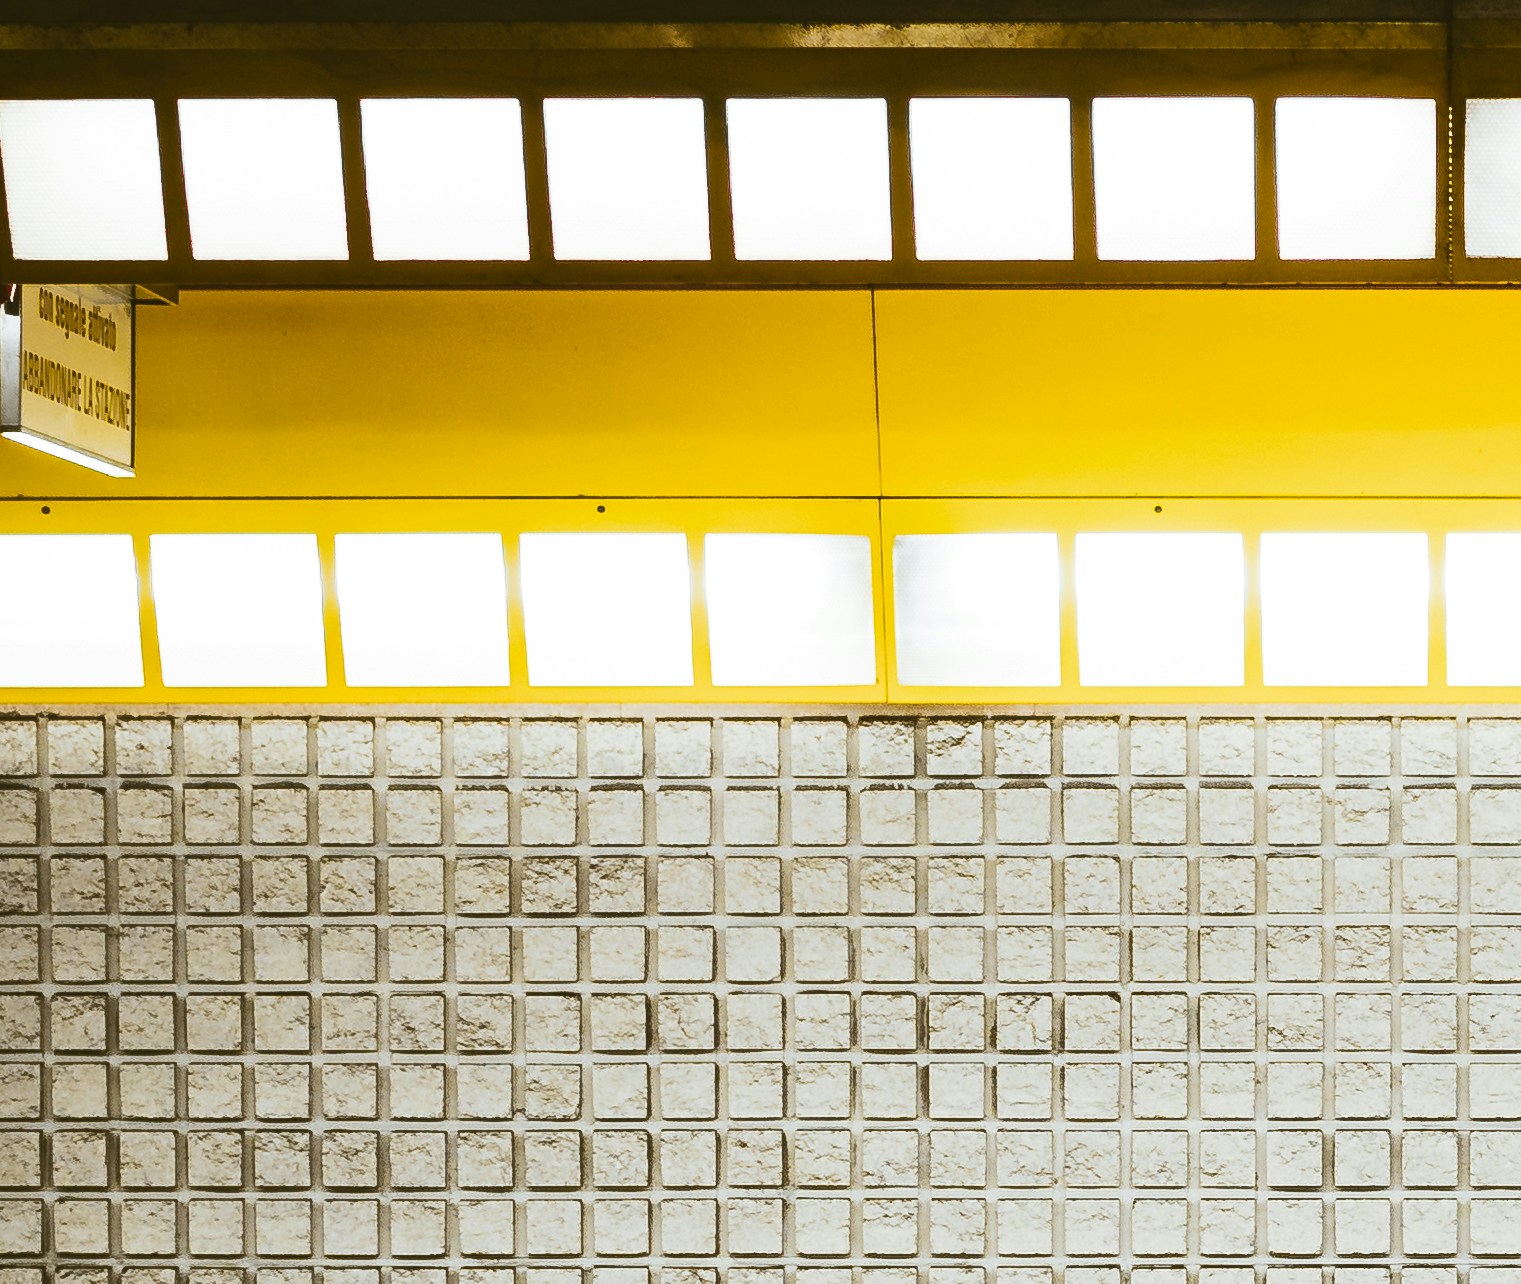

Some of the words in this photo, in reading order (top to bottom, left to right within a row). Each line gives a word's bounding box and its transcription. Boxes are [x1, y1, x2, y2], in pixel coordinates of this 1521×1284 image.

[39, 287, 53, 322] con
[55, 294, 87, 339] segnale
[88, 305, 117, 351] attivato
[22, 350, 82, 411] ABBANDONARE
[83, 374, 94, 417] LA
[95, 380, 130, 431] STAZIONE
